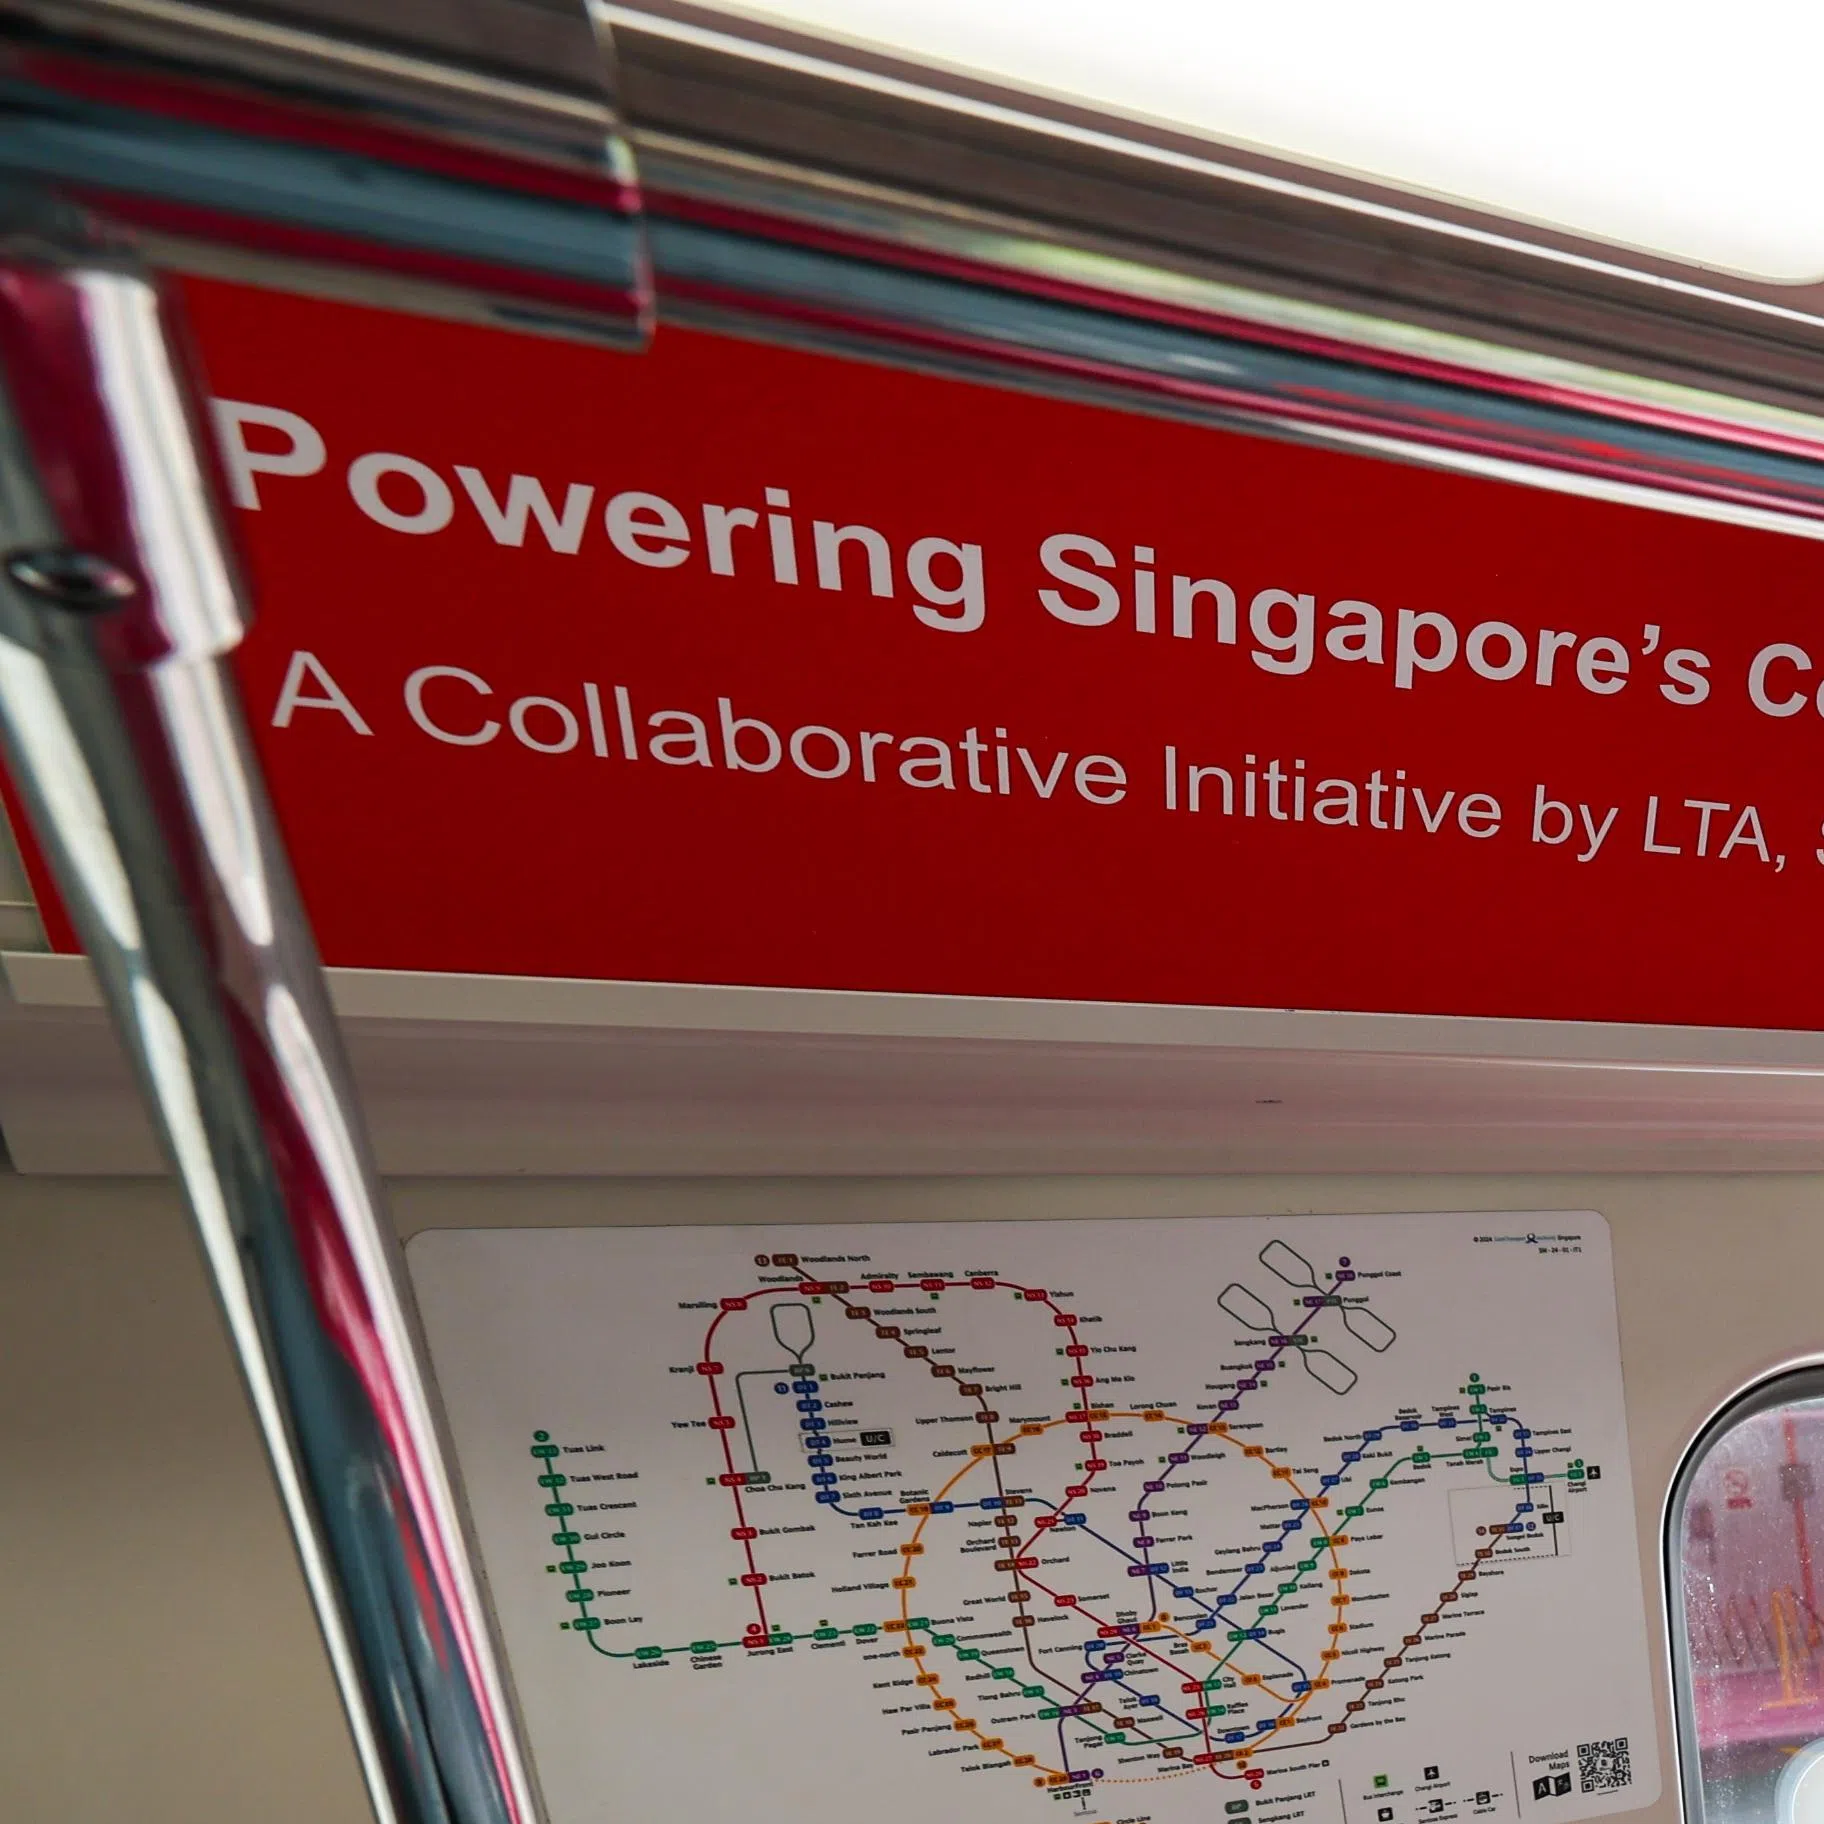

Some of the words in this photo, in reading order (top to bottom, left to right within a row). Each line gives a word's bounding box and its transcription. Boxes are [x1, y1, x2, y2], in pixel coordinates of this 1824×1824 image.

[214, 398, 988, 632] Powering
[272, 650, 373, 737] A
[404, 666, 1128, 806] Collaborative
[1164, 745, 1502, 839] Initiative
[1531, 784, 1617, 862] by
[1643, 795, 1786, 871] LTA,
[1528, 1750, 1569, 1764] Download
[1549, 1760, 1570, 1772] Maps
